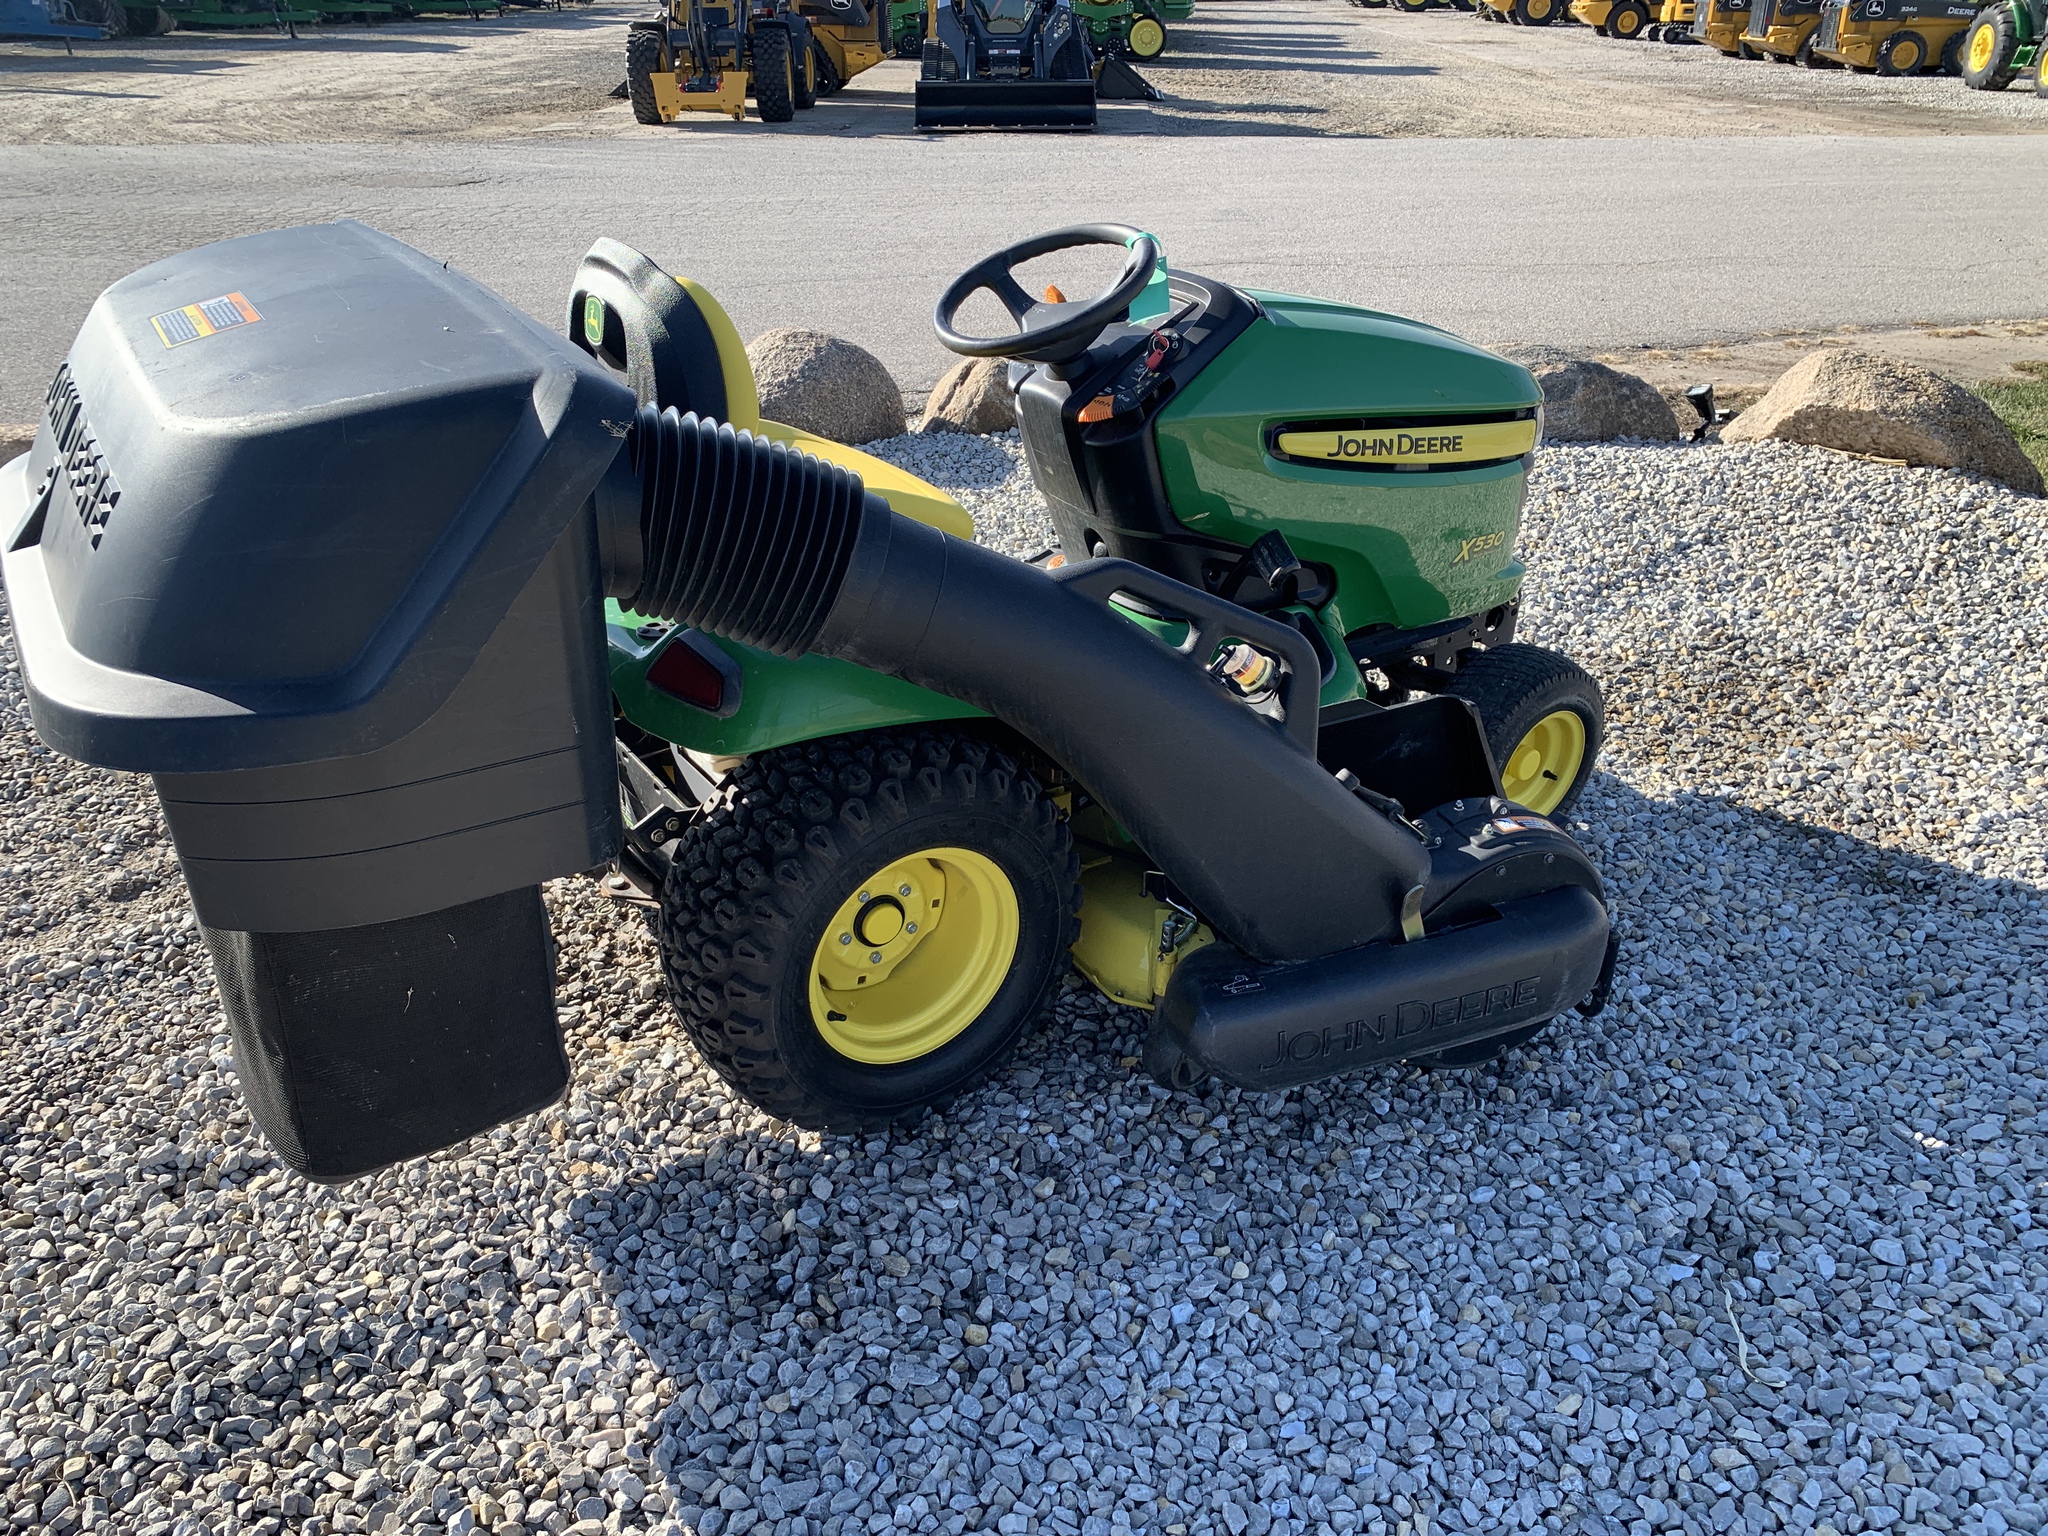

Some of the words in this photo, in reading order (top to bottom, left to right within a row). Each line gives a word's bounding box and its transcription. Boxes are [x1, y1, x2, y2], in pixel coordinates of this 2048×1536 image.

[1947, 6, 1976, 16] DEERE
[1327, 434, 1394, 457] JOHN
[1397, 433, 1463, 455] DEERE
[62, 410, 122, 552] DEERE
[1450, 530, 1505, 565] X530
[1259, 1013, 1387, 1072] JOHN
[1395, 975, 1541, 1039] DEERE
